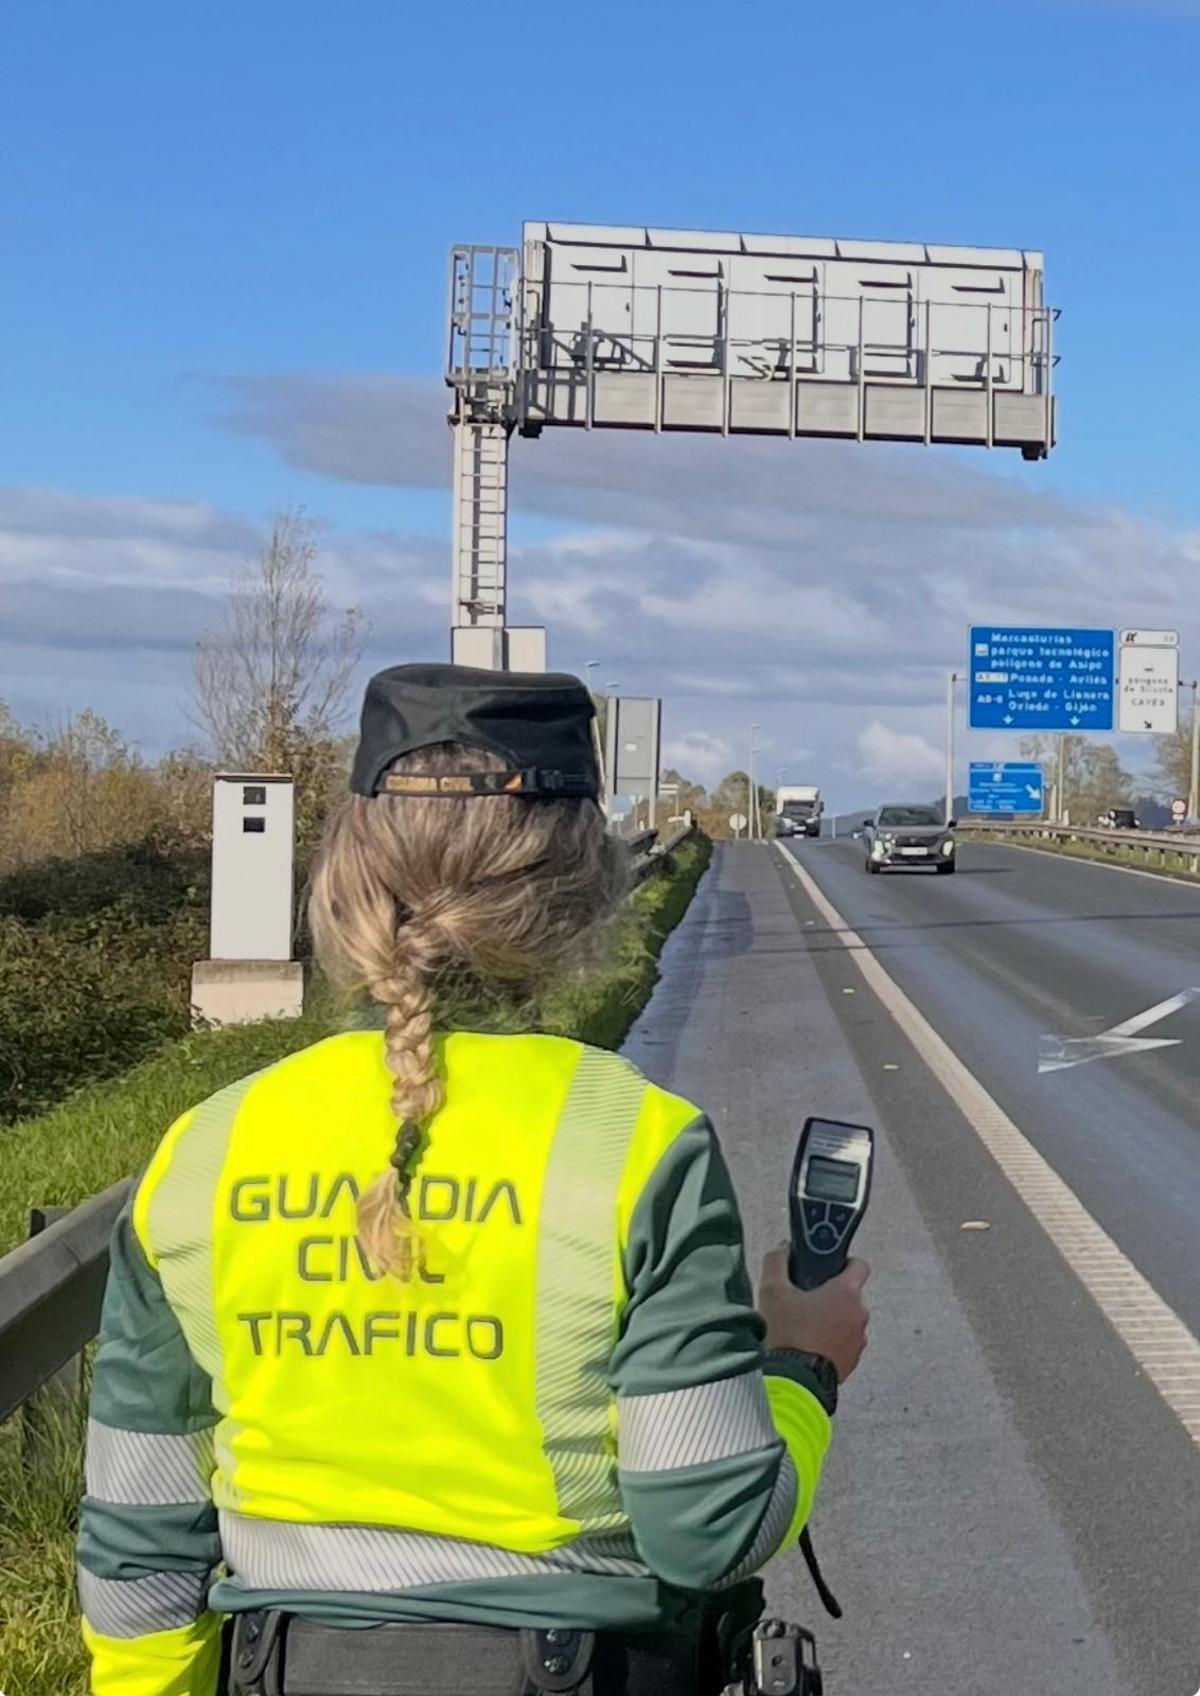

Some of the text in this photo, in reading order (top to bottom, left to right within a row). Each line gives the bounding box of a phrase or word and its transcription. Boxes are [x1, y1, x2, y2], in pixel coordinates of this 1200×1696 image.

[990, 647, 1110, 659] parque tecnológico
[990, 659, 1103, 672] polígono de Asipo
[1010, 673, 1054, 683] Posada
[1069, 674, 1108, 685] Avilés
[1008, 689, 1110, 701] Lugo de Llanera
[1008, 702, 1050, 712] Oviedo
[1064, 703, 1098, 714] Gijón
[237, 1310, 504, 1360] TRAFICO
